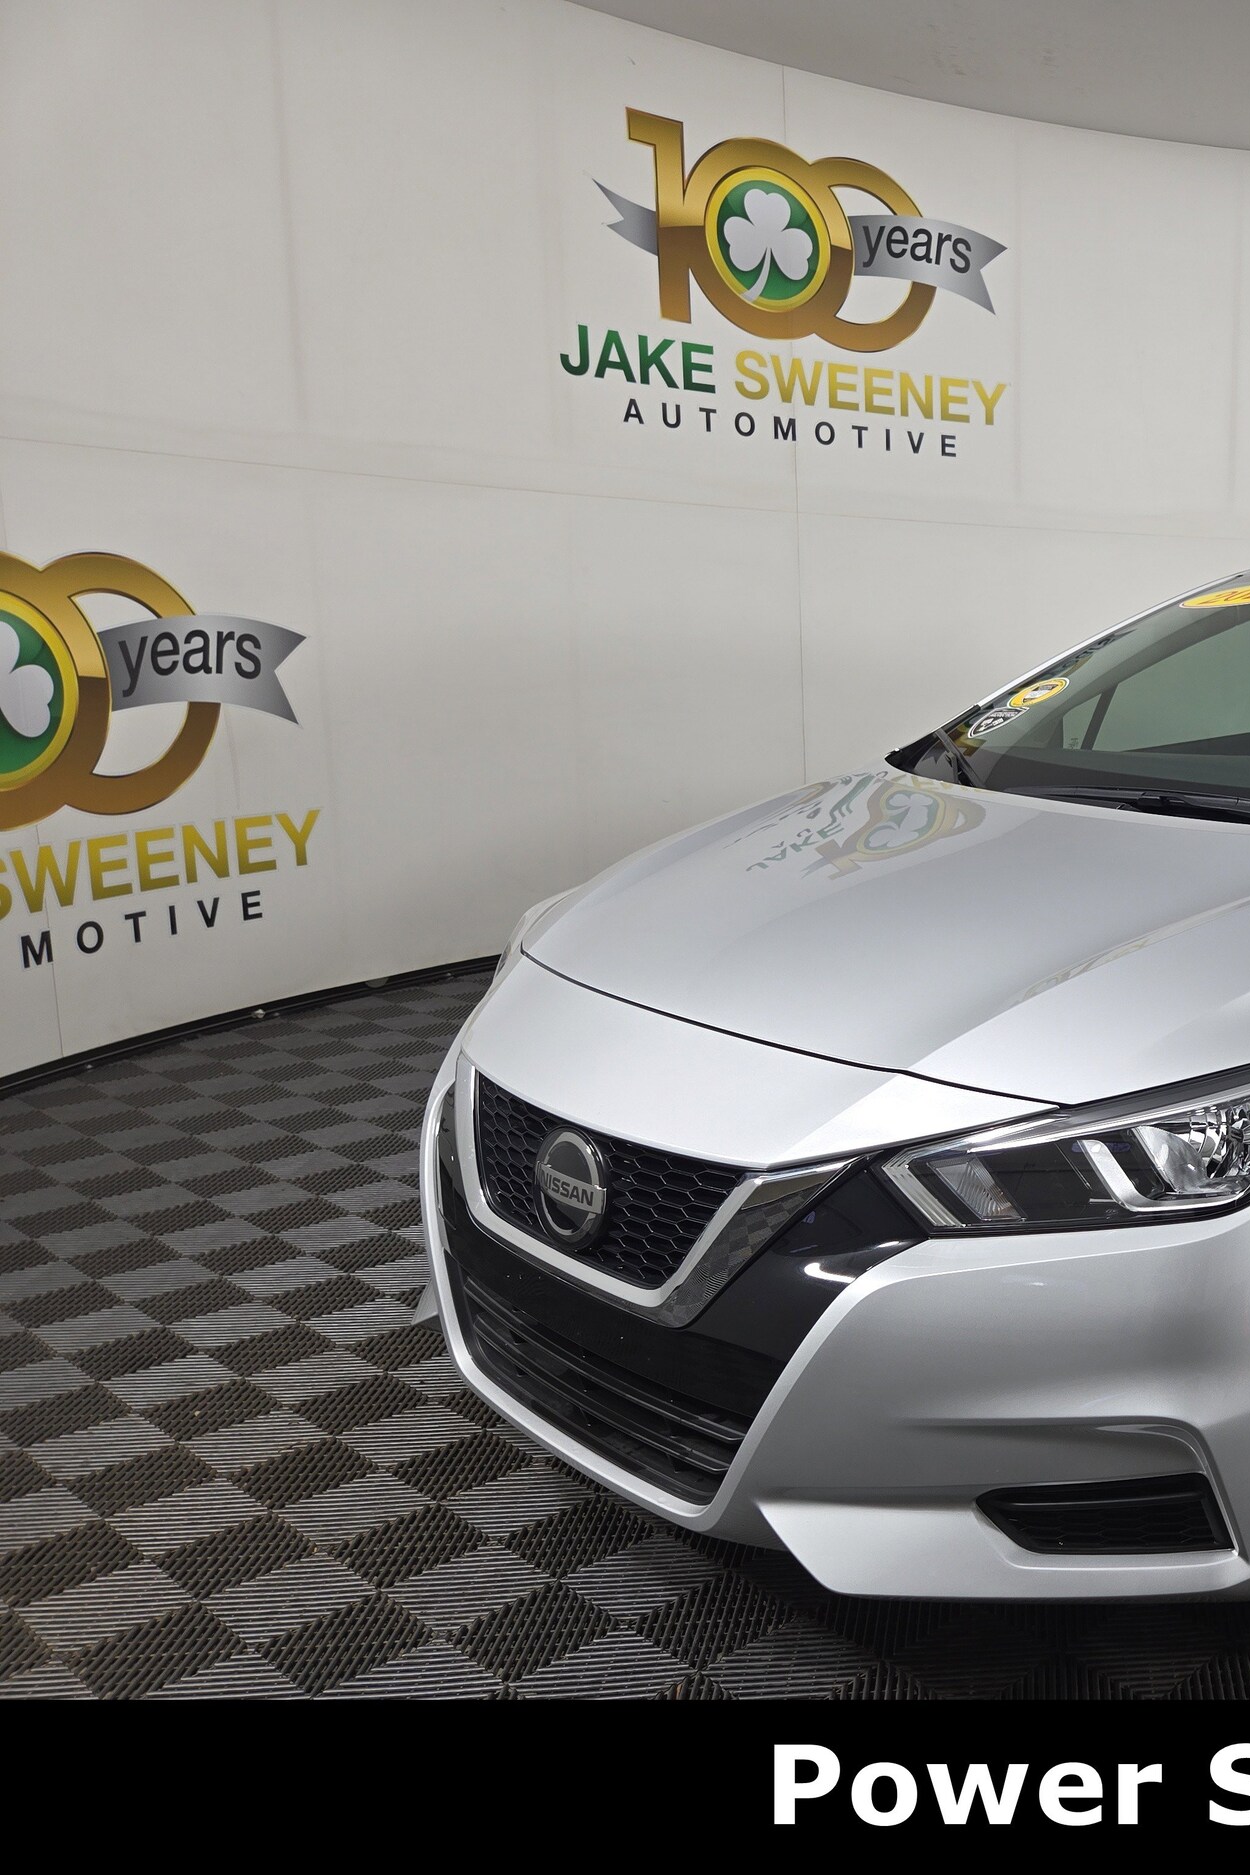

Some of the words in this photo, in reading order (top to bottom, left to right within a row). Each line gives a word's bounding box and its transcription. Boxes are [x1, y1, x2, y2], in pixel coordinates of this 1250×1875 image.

[862, 223, 972, 275] years
[559, 323, 716, 395] JAKE
[734, 350, 1007, 426] SWEENEY
[622, 397, 958, 458] AUTOMOTIVE
[117, 629, 263, 699] years
[0, 809, 321, 921] WEENEY
[540, 1168, 594, 1207] NISSAN
